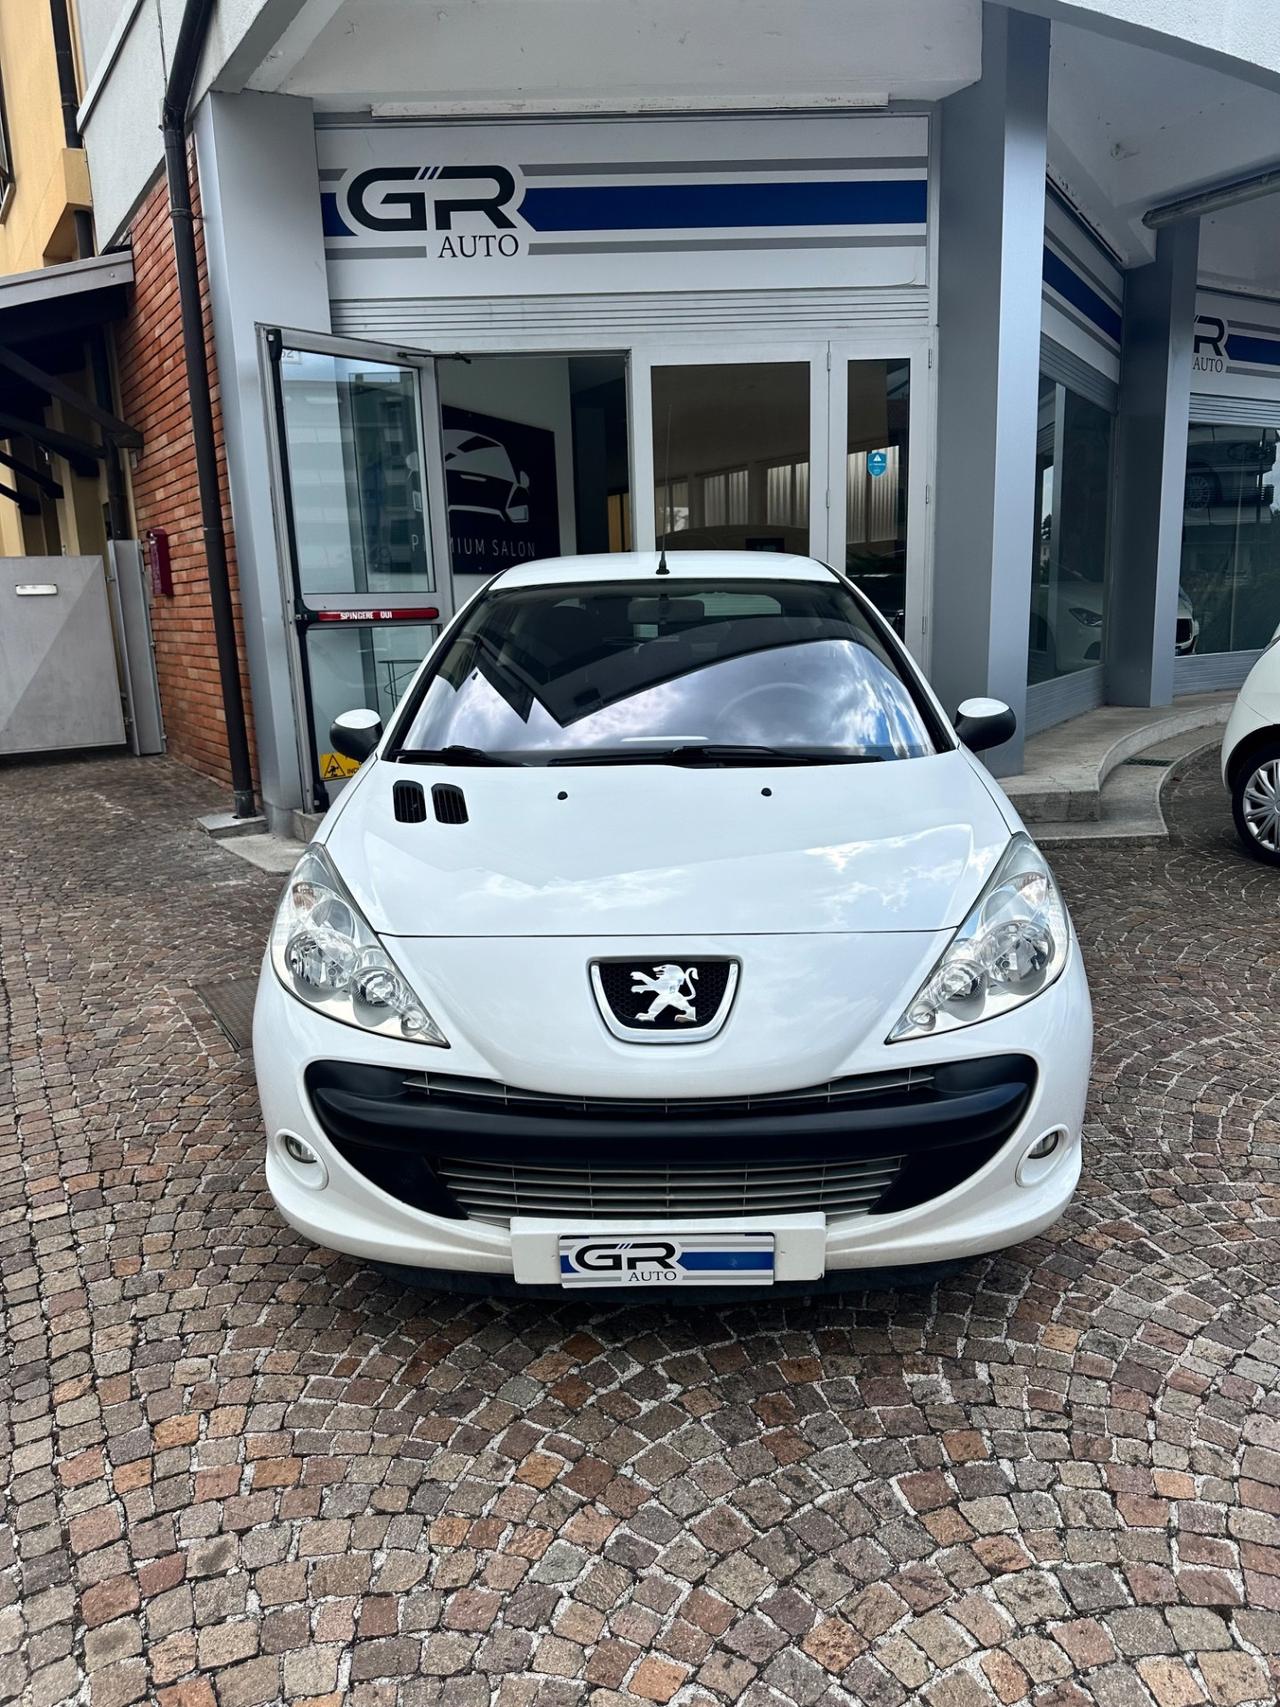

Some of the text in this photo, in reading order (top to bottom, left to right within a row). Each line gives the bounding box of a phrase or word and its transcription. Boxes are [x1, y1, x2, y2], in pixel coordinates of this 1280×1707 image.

[347, 165, 518, 232] GR
[438, 234, 519, 258] AUTO
[1194, 315, 1224, 356] R
[1193, 357, 1224, 373] AUTO
[492, 539, 536, 557] SALON
[575, 1242, 676, 1271] GR
[628, 1271, 676, 1281] AUTO
